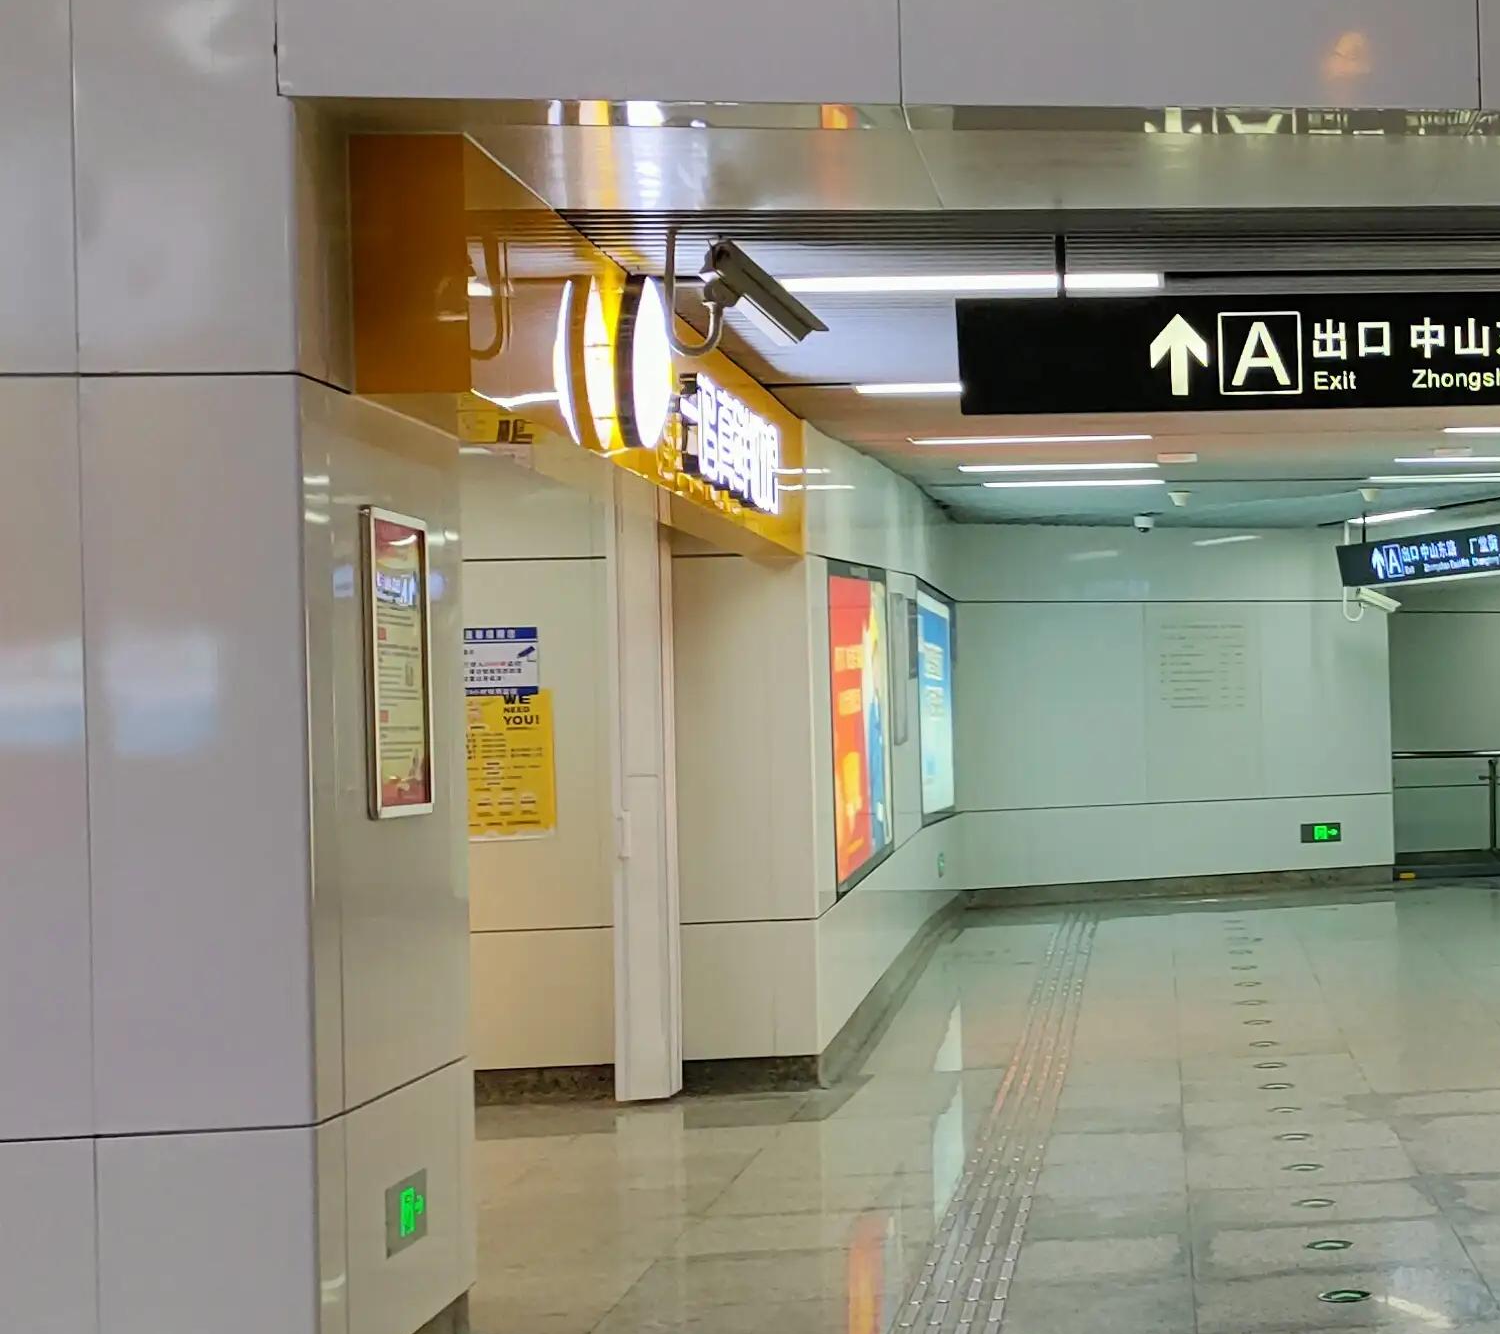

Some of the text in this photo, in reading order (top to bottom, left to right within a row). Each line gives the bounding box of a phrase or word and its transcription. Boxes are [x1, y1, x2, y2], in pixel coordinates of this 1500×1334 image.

[1312, 318, 1391, 360] 出口
[1231, 321, 1292, 386] A
[1313, 370, 1357, 390] Exit
[1388, 548, 1402, 574] A
[503, 692, 531, 705] WE
[503, 706, 531, 714] NEED
[503, 714, 541, 725] YOU!
